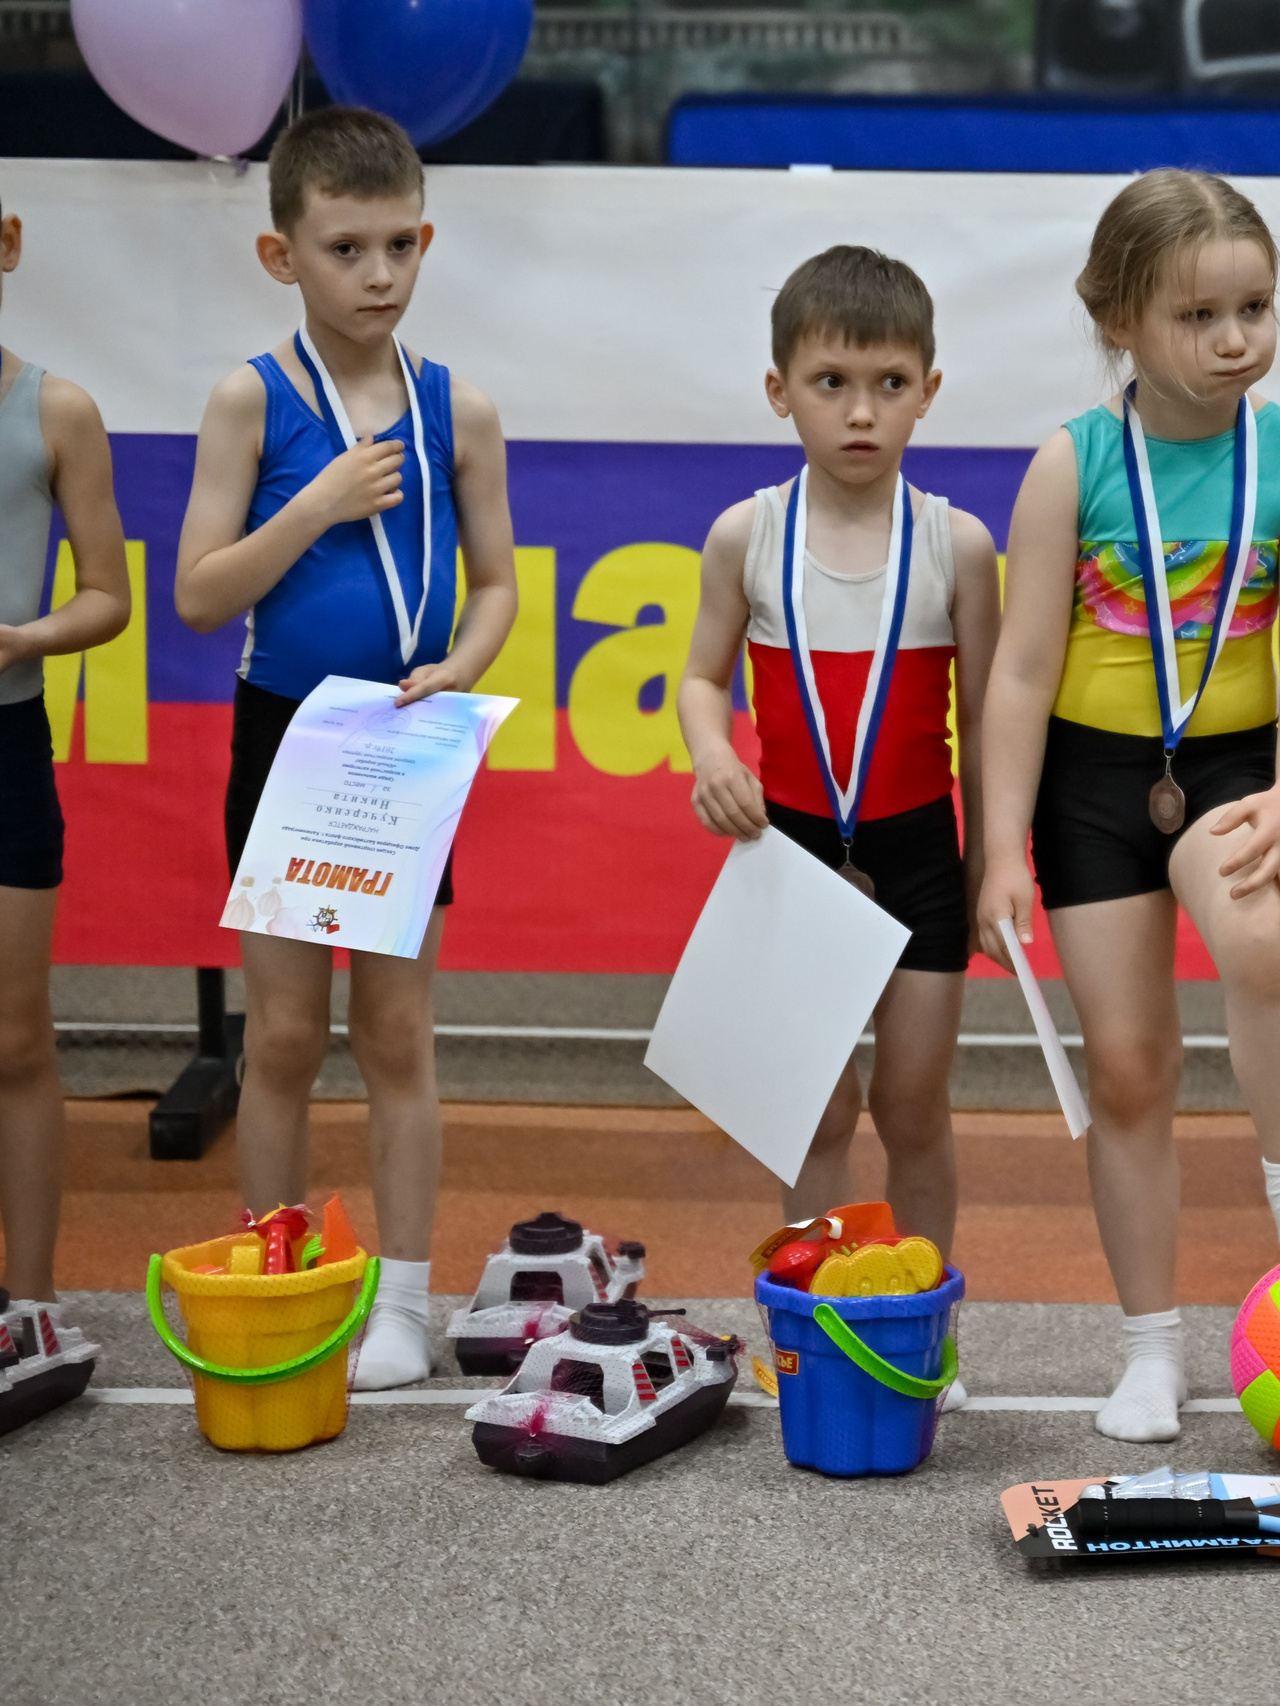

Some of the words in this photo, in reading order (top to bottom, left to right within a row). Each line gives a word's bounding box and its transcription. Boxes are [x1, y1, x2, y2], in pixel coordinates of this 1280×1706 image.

[344, 780, 365, 788] место
[333, 793, 389, 810] Никита
[316, 803, 398, 826] Кучеренко
[328, 821, 379, 834] НАГРАЖДАЕТСЯ
[285, 857, 393, 896] ГРАМОТА
[1030, 1485, 1078, 1552] ROCKET
